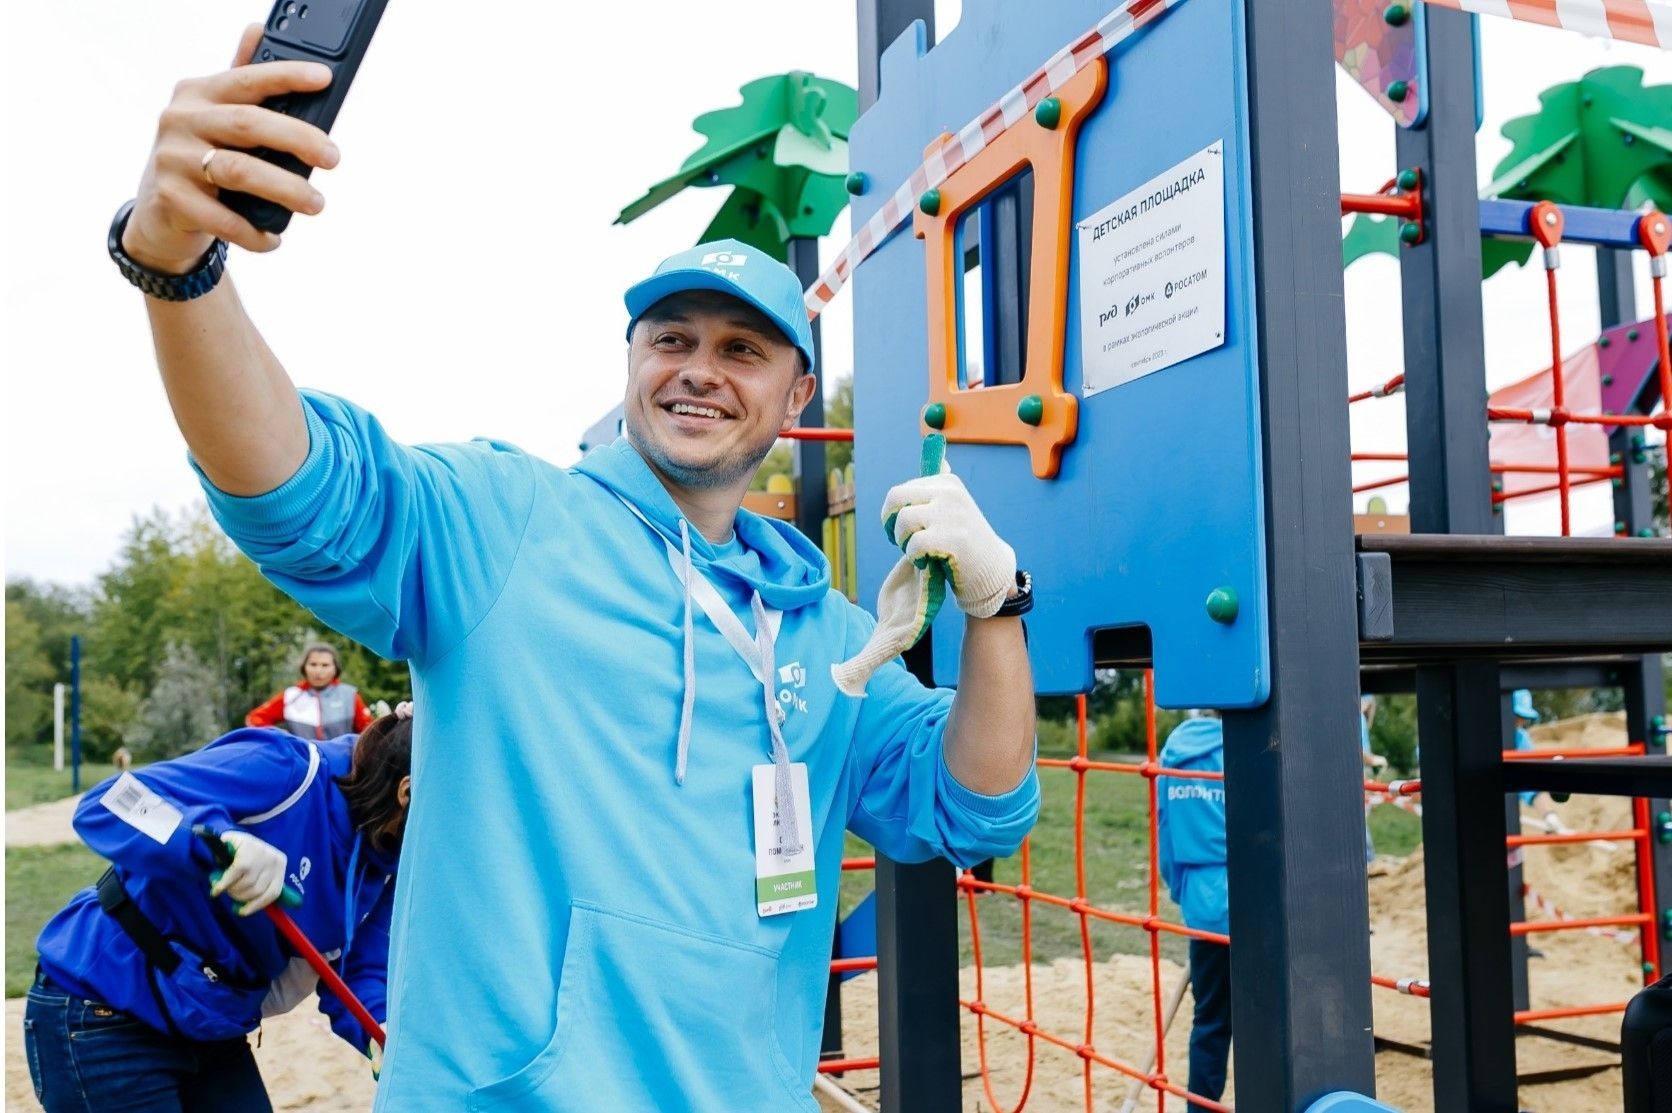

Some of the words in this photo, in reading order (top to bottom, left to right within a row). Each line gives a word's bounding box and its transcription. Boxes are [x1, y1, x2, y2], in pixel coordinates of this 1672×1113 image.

[1093, 205, 1138, 242] ДЕТСКАЯ
[1140, 168, 1205, 214] ПЛОЩАДКА
[1113, 237, 1154, 266] установлена
[1155, 224, 1182, 242] силами
[1103, 257, 1153, 286] корпоративных
[1141, 292, 1155, 305] ОМК
[1174, 269, 1208, 292] РОСАТОМ
[1178, 306, 1198, 321] акции
[779, 688, 808, 714] ОМК
[1168, 785, 1225, 804] ВОЛОНТ
[773, 879, 803, 893] УЧАСТНИК
